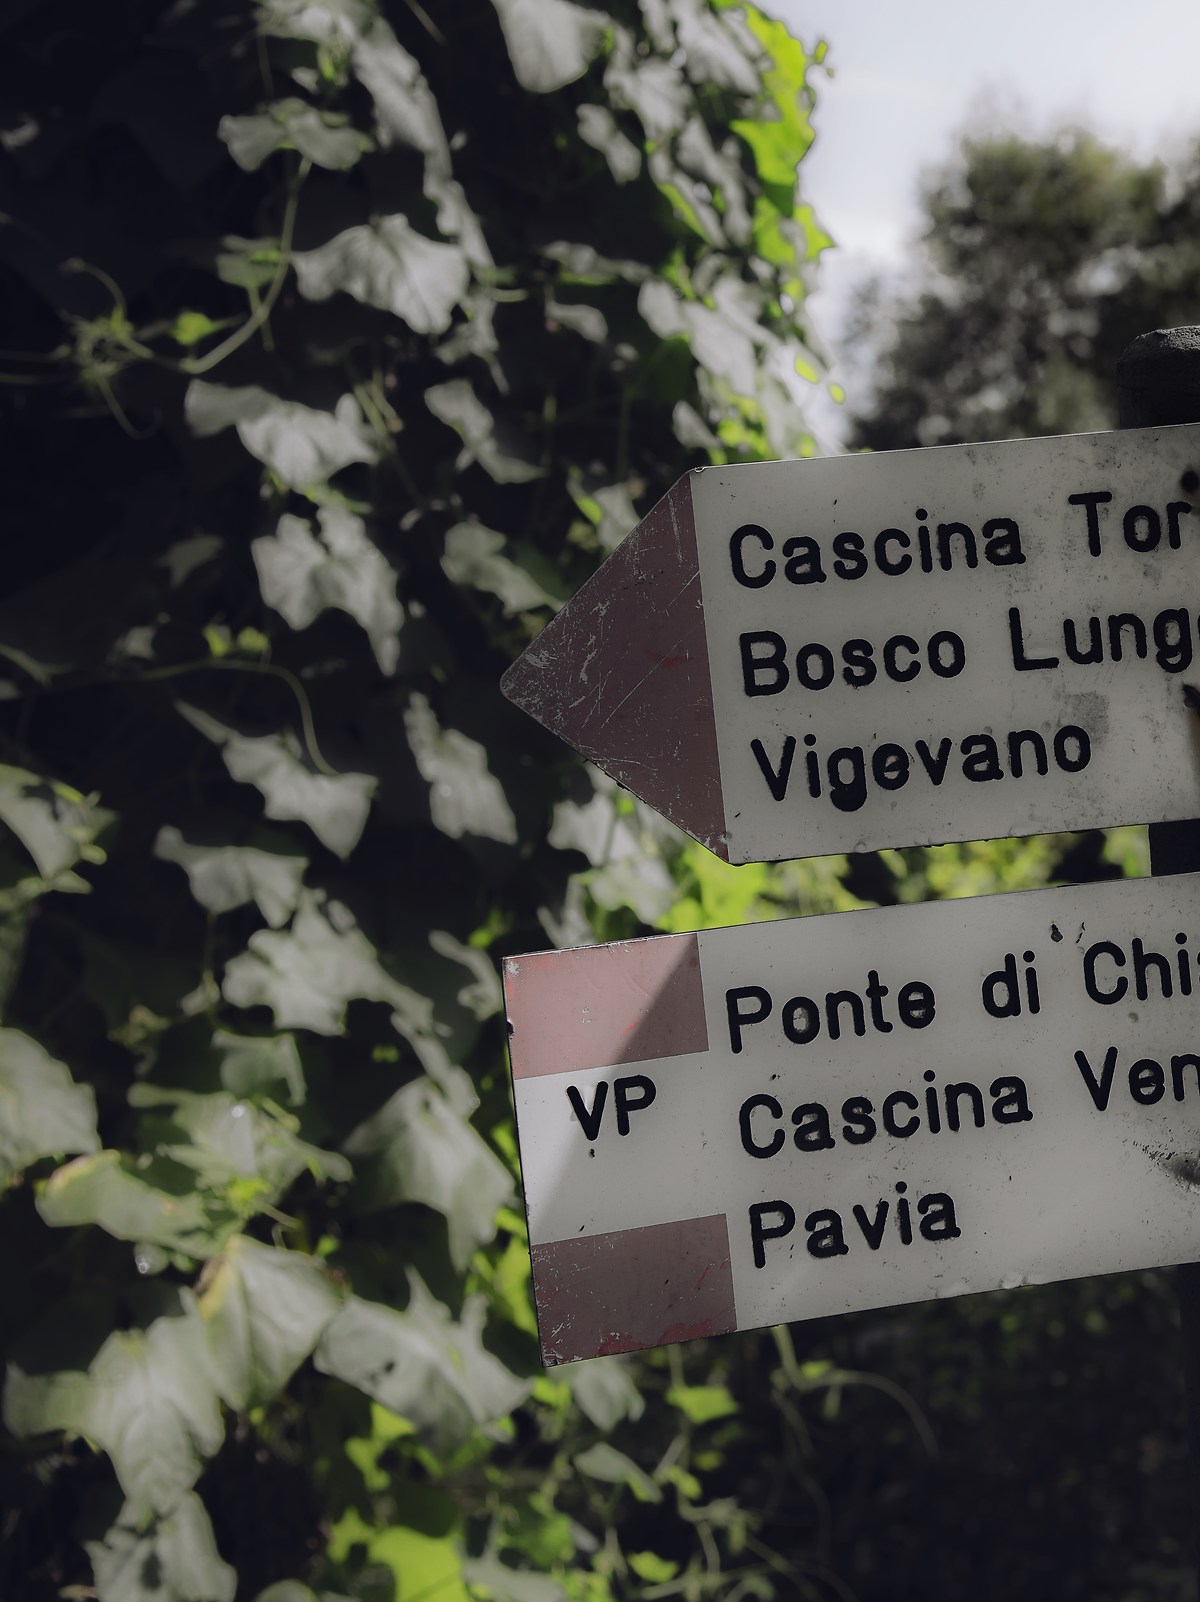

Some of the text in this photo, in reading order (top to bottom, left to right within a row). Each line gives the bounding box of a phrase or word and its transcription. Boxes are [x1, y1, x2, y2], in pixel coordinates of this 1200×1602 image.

[730, 508, 1025, 588] Cascina
[739, 629, 965, 697] Bosco
[751, 725, 1091, 811] Vigevano
[725, 970, 936, 1053] Ponte
[981, 951, 1040, 1018] di
[566, 1075, 656, 1141] VP
[739, 1070, 1032, 1159] Cascina
[749, 1181, 961, 1269] Pavia
